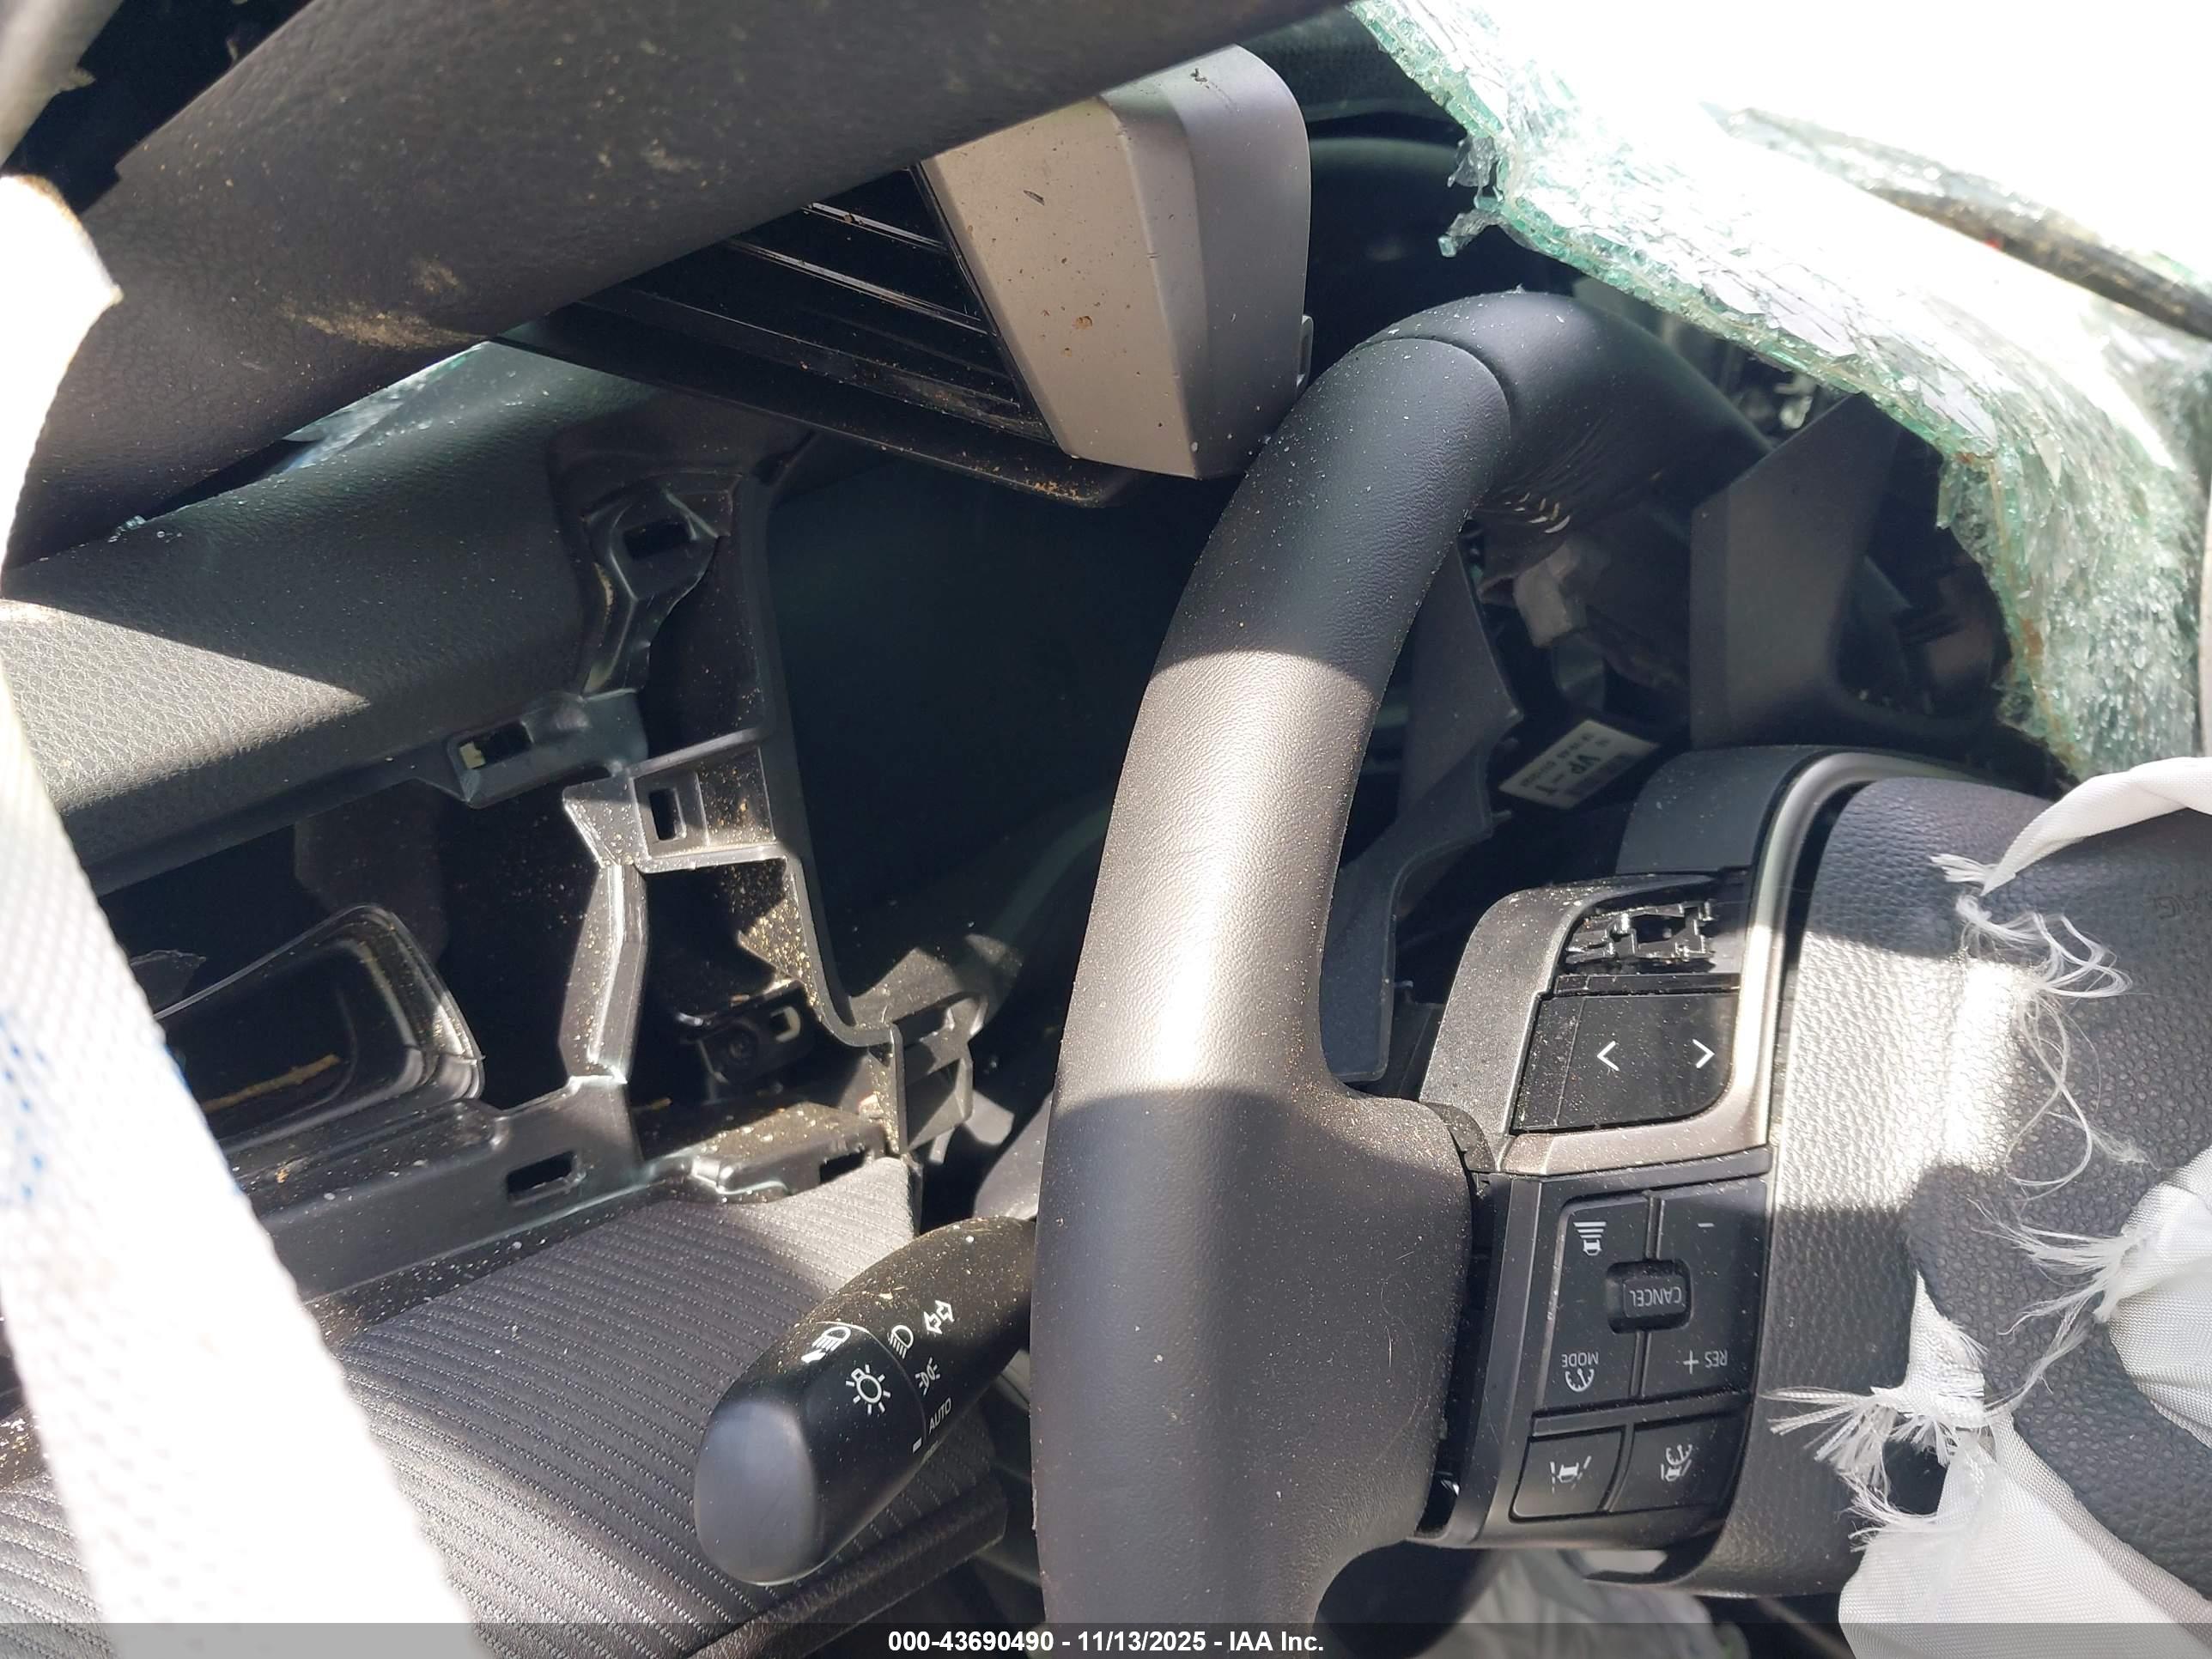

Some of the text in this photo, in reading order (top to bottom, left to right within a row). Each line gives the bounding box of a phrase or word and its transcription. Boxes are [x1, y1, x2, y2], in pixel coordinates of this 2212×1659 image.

[1629, 1285, 1683, 1307] CANCEL
[1561, 1352, 1599, 1368] MODE
[1705, 1349, 1728, 1368] RES
[929, 1397, 951, 1433] AUTO
